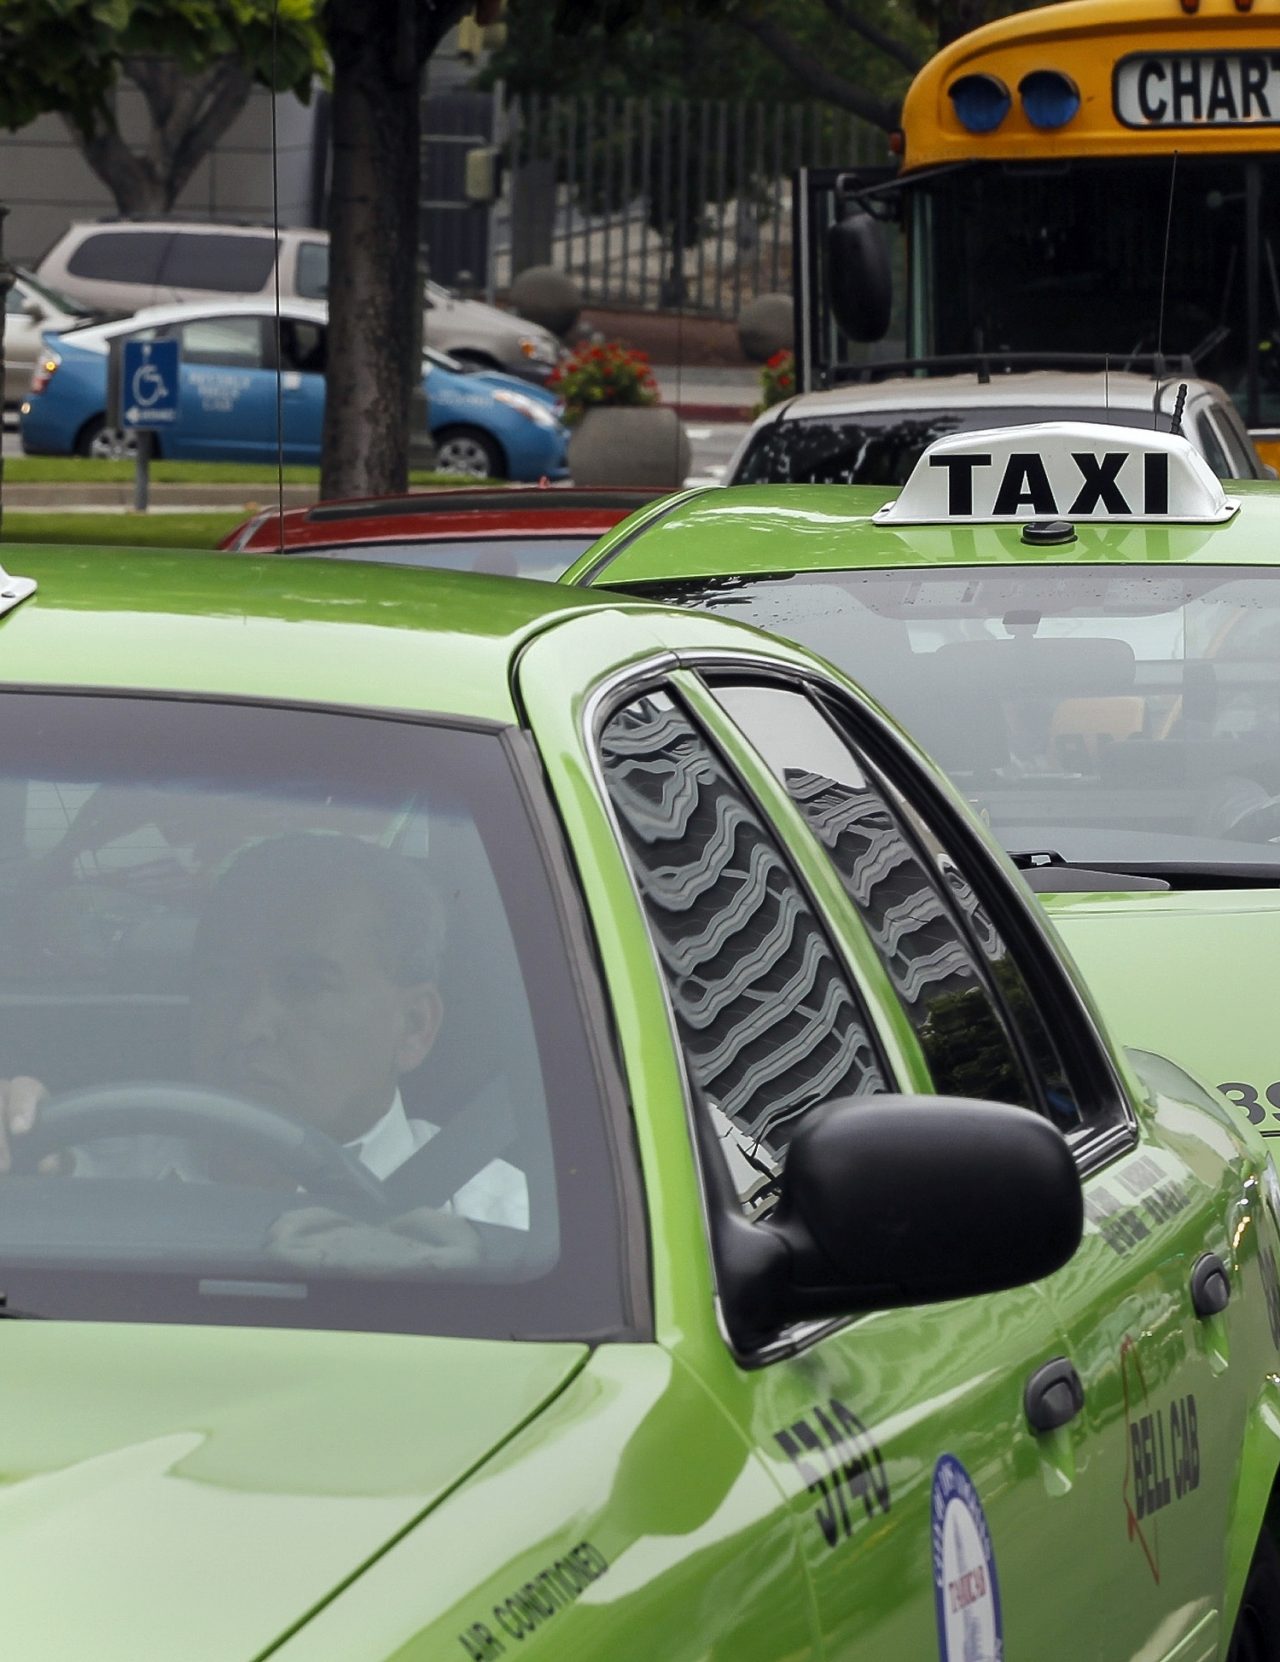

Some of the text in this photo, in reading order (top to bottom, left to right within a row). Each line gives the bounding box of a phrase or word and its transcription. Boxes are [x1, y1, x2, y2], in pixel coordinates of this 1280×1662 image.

[929, 452, 1169, 516] TAXI
[773, 1397, 892, 1548] 5740
[1130, 1393, 1200, 1521] BELL CAB
[458, 1540, 609, 1662] AIR CONDITIONED
